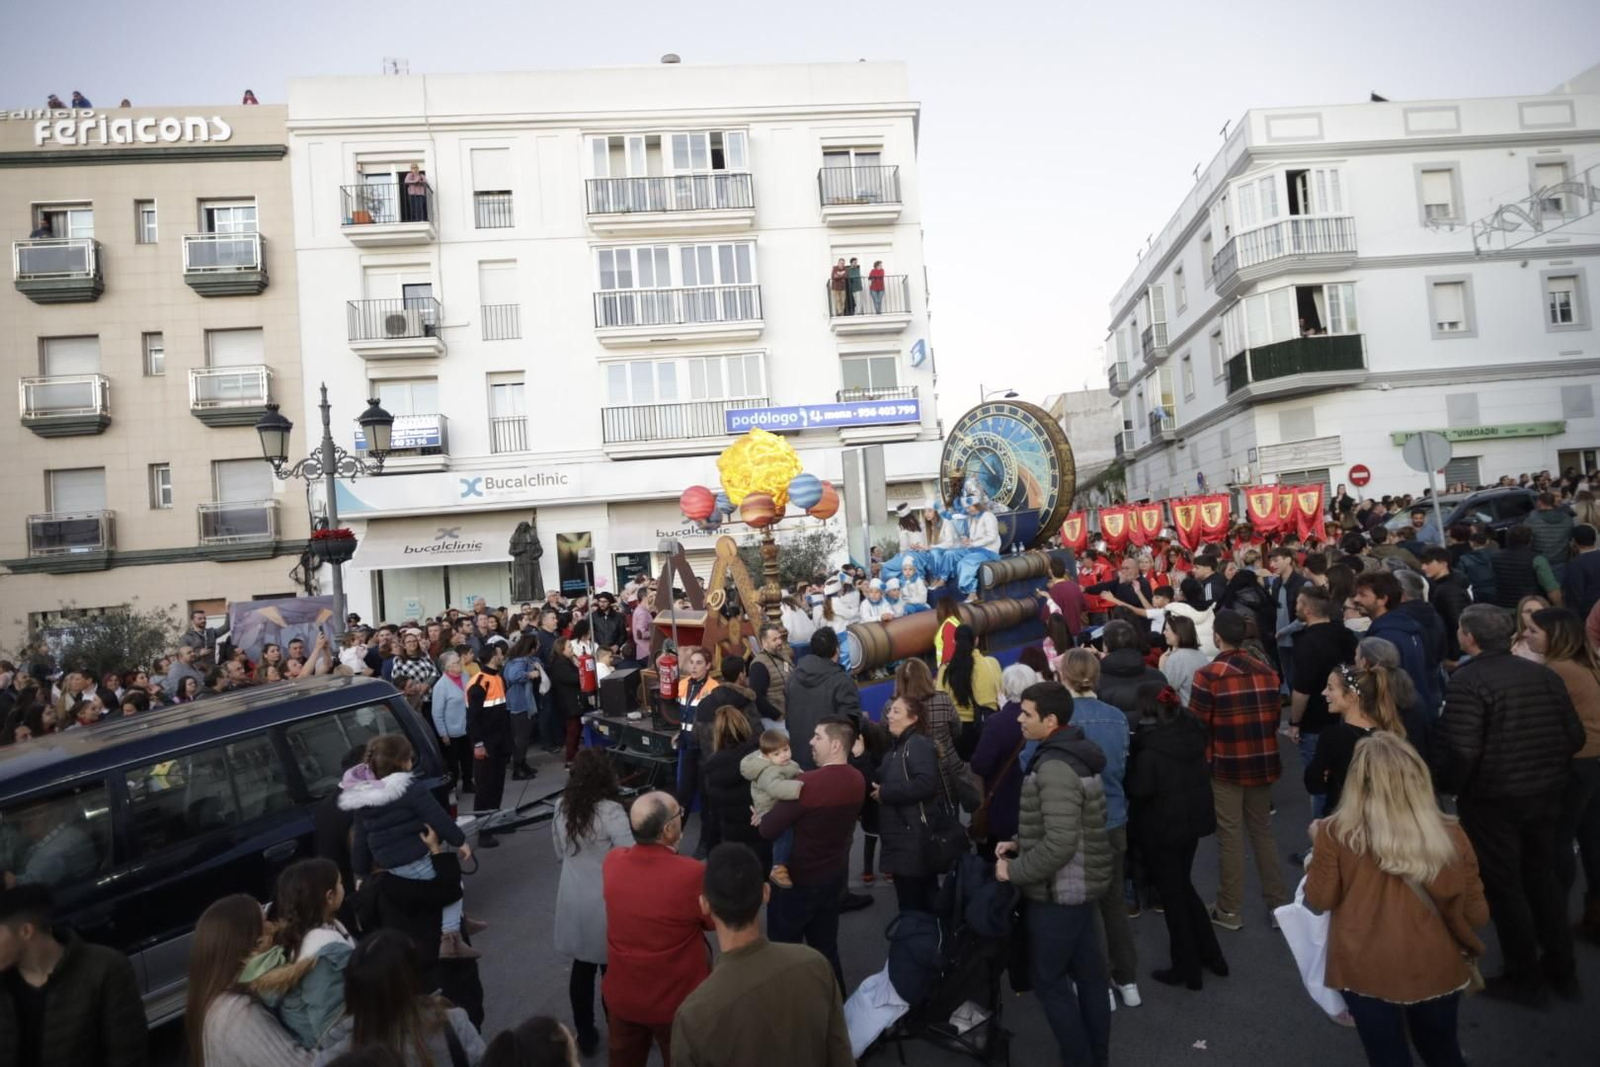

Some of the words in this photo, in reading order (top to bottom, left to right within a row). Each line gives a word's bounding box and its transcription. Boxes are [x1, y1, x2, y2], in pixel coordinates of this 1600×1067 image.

[732, 412, 798, 428] podólogo
[897, 404, 916, 415] 799
[485, 472, 569, 490] Bucalclinic
[404, 540, 483, 554] bucalclinic
